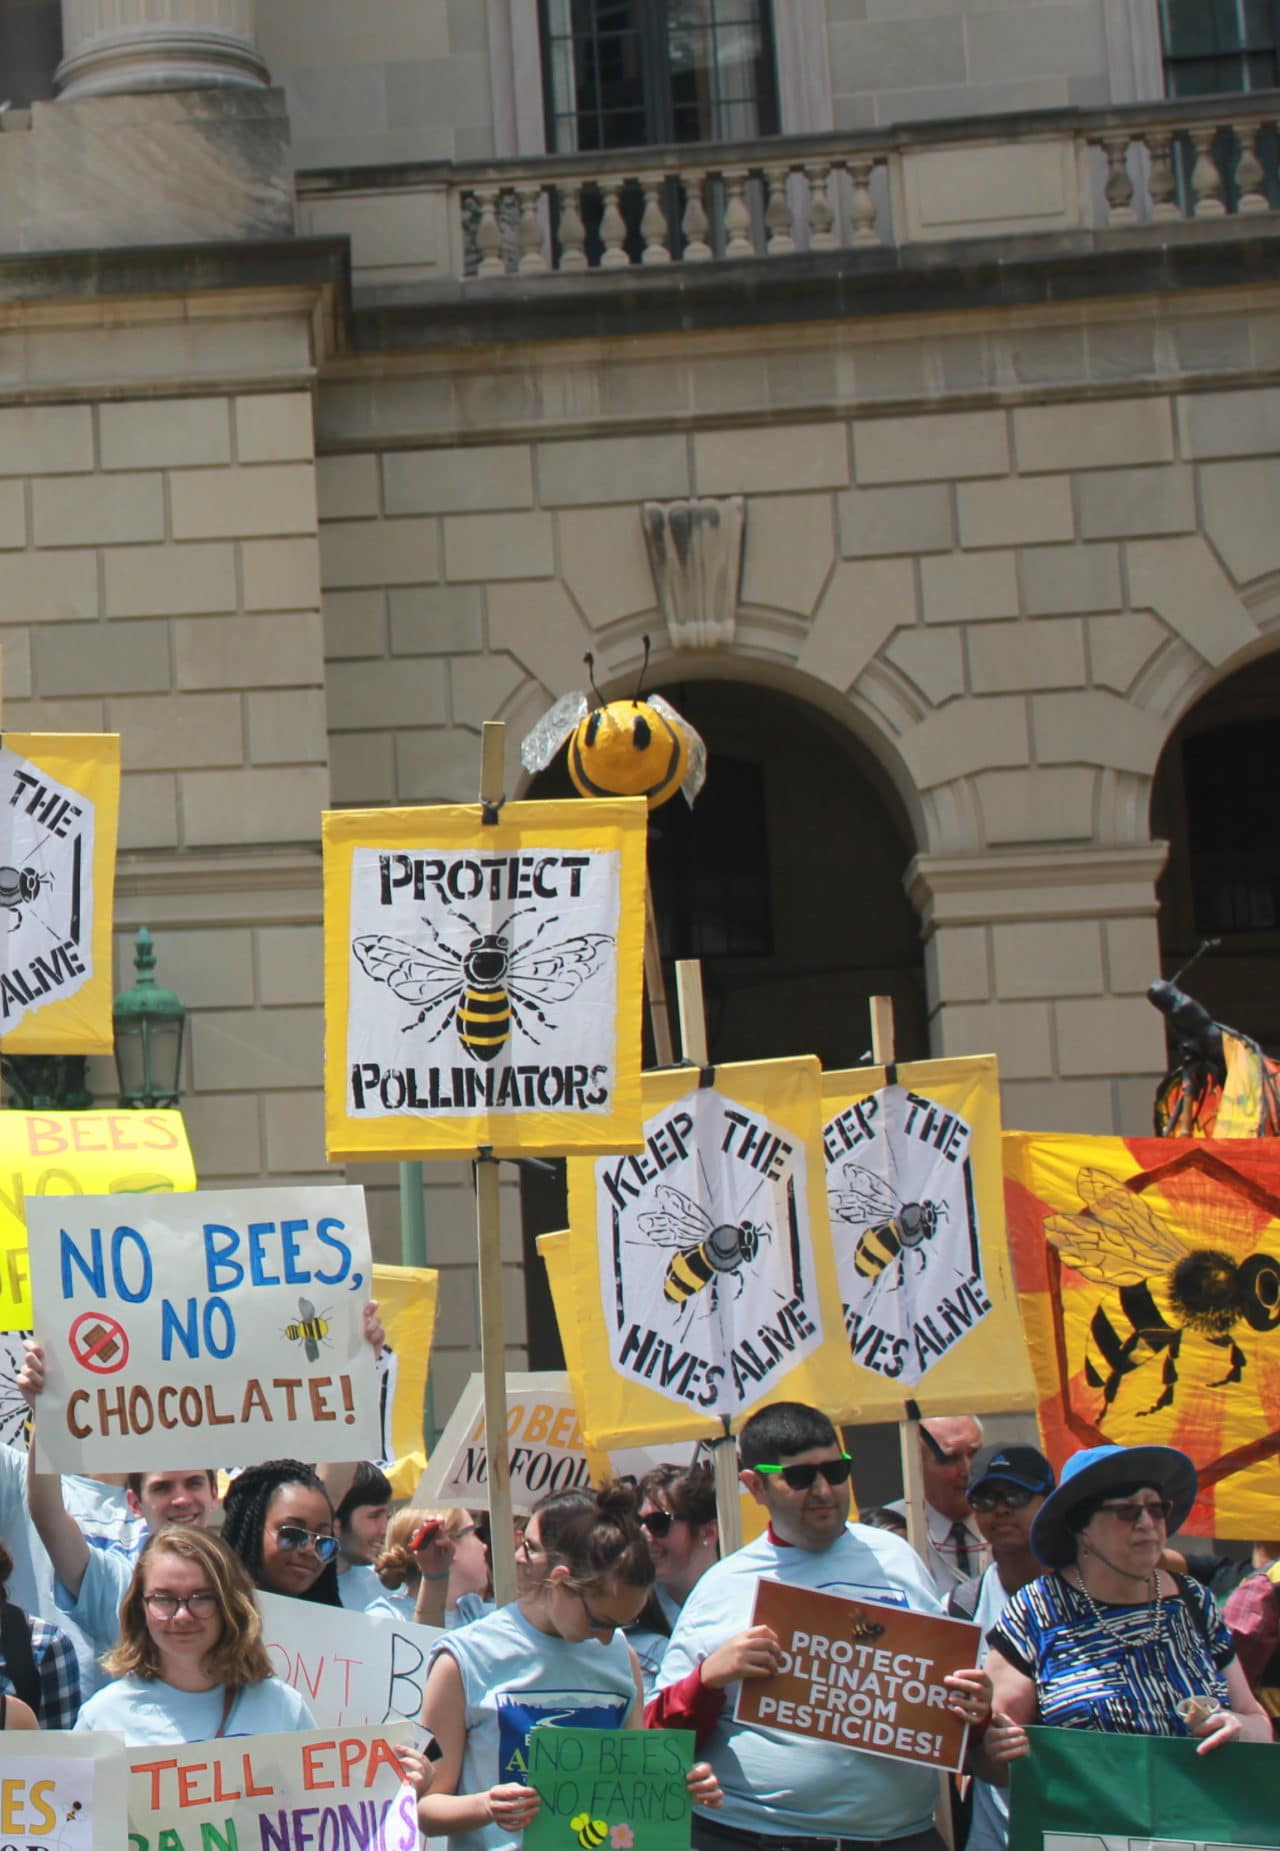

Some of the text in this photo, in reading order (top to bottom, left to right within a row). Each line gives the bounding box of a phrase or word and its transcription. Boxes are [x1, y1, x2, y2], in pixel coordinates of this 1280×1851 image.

[7, 770, 82, 840] THE
[379, 854, 590, 906] PROTECT
[351, 1062, 608, 1110] POLLINATORS
[27, 1116, 179, 1156] BEES
[822, 1092, 969, 1165] EEP THE
[602, 1109, 794, 1211] KEEP THE
[59, 1217, 363, 1303] NO BEES,
[160, 1296, 236, 1362] NO
[66, 1373, 356, 1440] CHOCOLATE!
[775, 1650, 974, 1712] OLLINATORS
[791, 1630, 934, 1681] PROTECT
[758, 1695, 943, 1758] PESTICIDES!
[809, 1682, 897, 1723] FROM
[130, 1738, 410, 1810] TELL EPA
[534, 1737, 584, 1773] NO
[535, 1780, 688, 1822] NO FARMS
